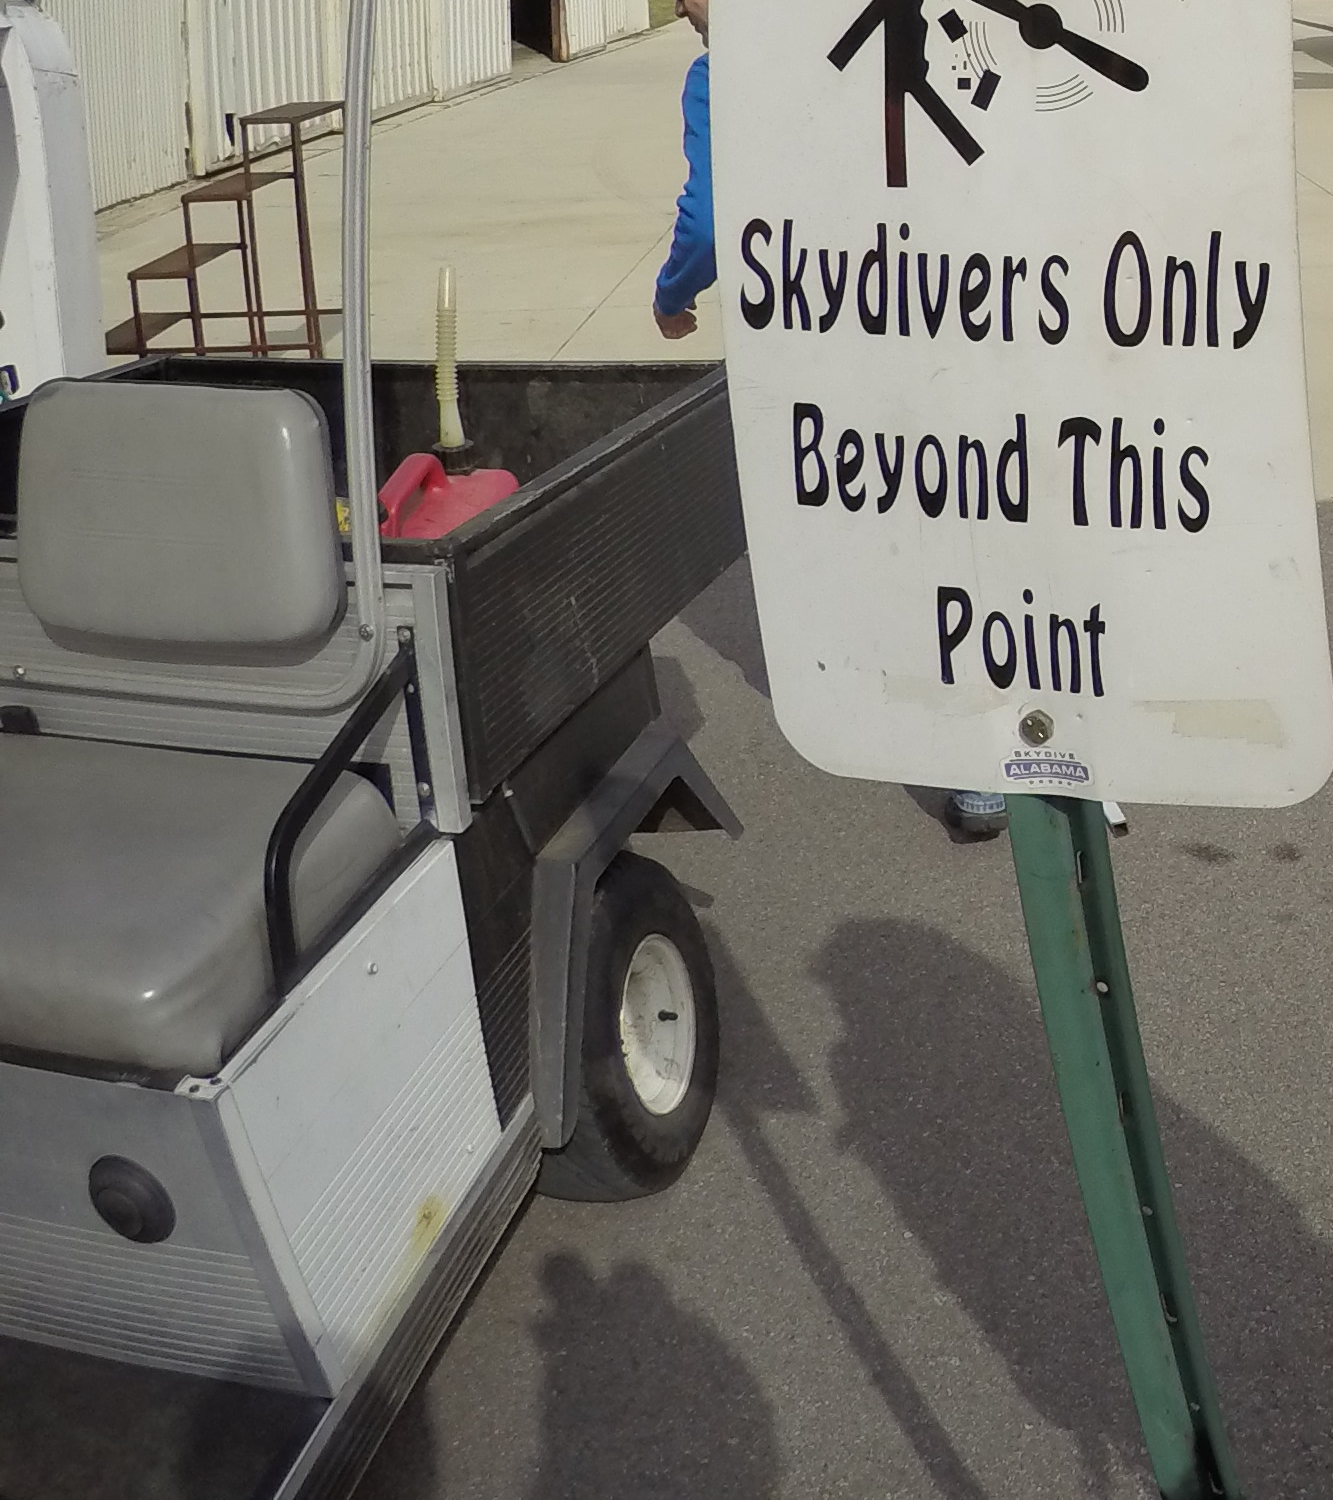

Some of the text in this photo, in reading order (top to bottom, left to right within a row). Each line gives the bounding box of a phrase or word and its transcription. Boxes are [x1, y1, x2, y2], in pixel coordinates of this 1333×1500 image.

[740, 218, 1270, 350] Skydivers Only
[793, 402, 1210, 534] Beyond This
[937, 585, 1106, 698] Point
[1008, 763, 1086, 778] ALABAMA
[1013, 750, 1076, 760] SKYDIVE
